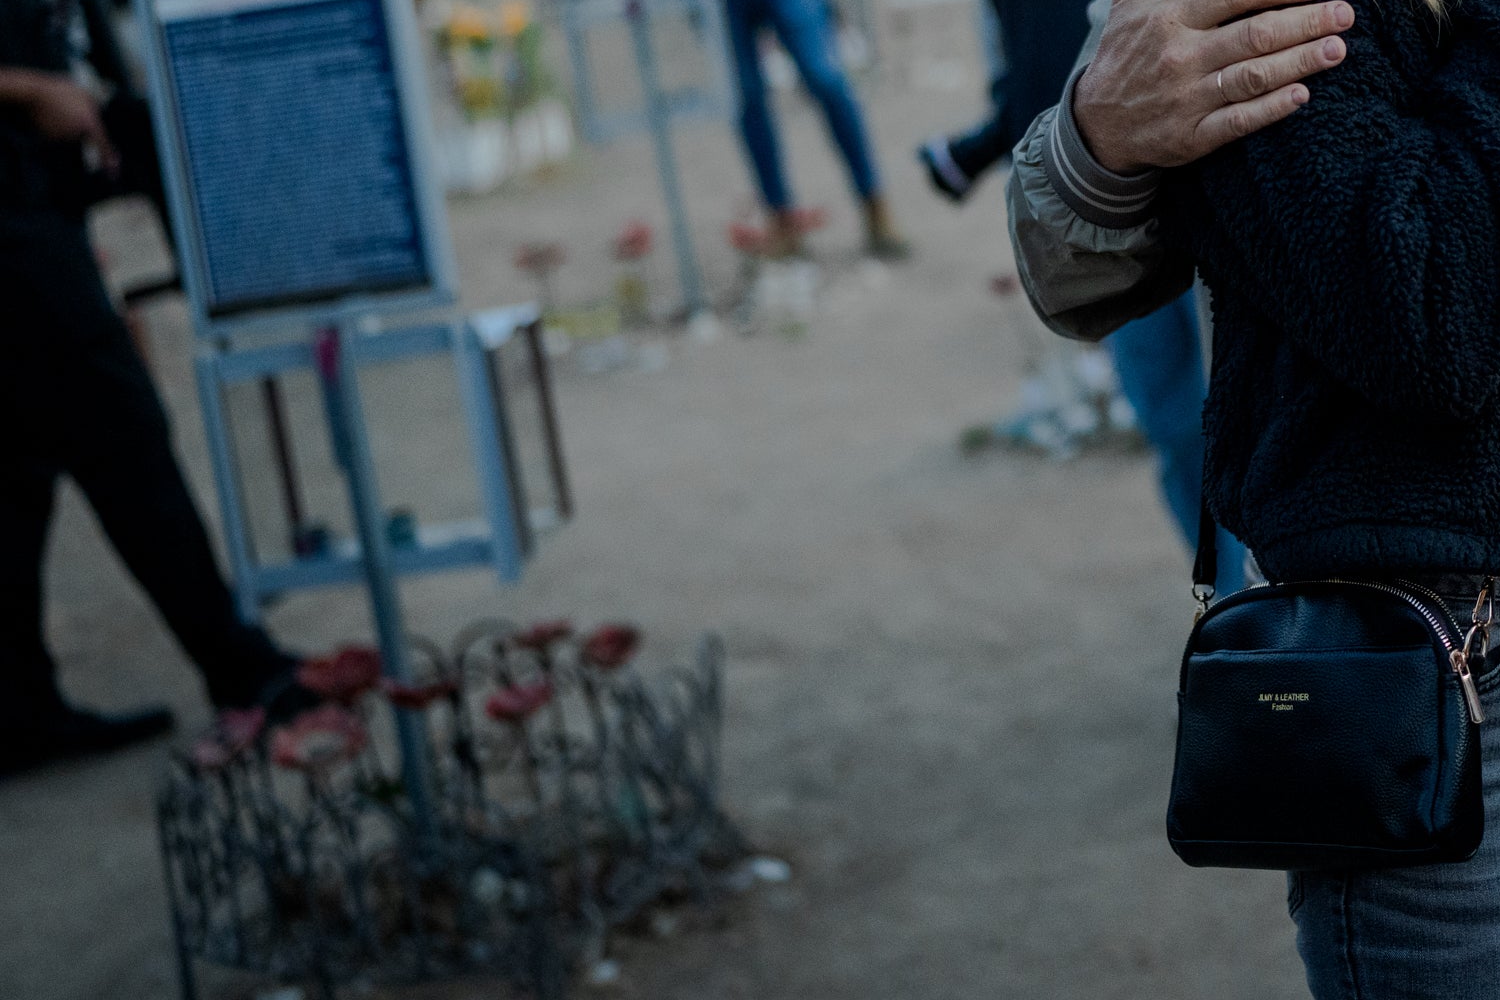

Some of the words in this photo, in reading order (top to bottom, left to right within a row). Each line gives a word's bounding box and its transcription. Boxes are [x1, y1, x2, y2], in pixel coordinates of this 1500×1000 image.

[1274, 693, 1279, 701] &
[1280, 693, 1309, 701] LEATHER
[1271, 703, 1293, 711] Fashion
